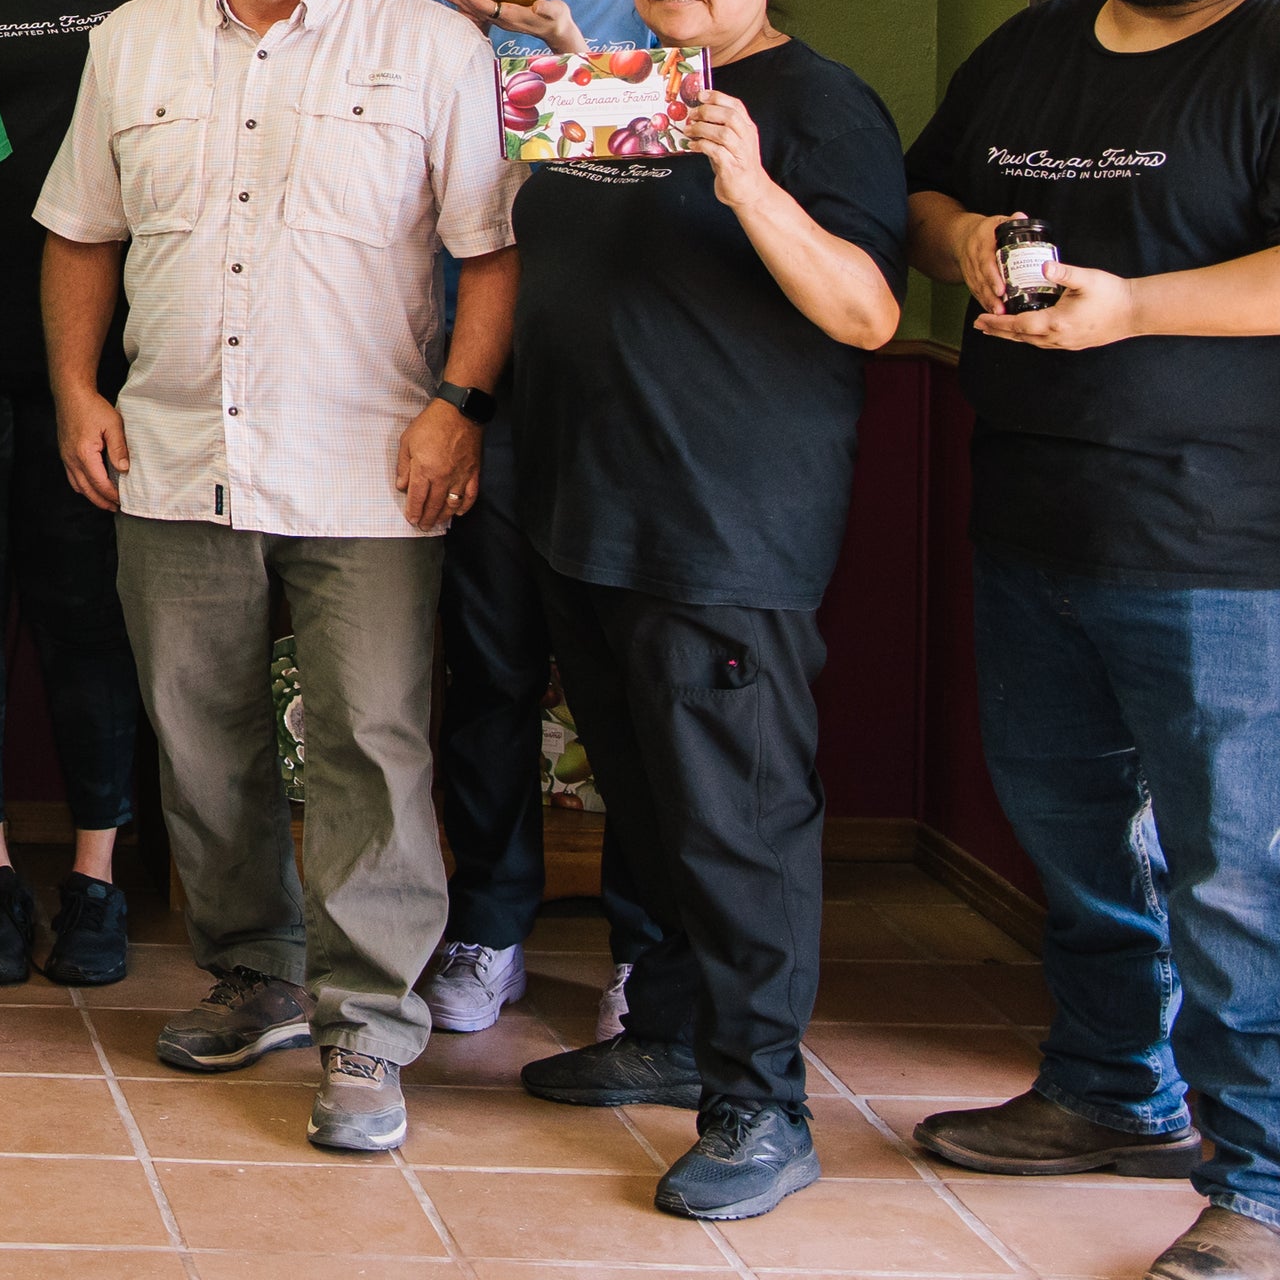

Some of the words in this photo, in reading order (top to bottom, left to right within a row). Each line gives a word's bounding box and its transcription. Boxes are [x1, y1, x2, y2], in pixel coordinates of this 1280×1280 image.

[59, 11, 113, 27] Farm
[61, 25, 94, 34] UTOPI
[548, 95, 574, 107] New
[577, 94, 620, 106] Canaan
[623, 91, 661, 103] Farms
[987, 146, 1026, 166] New
[1097, 148, 1167, 167] Farms
[622, 164, 673, 179] Farms
[1079, 170, 1090, 179] IN
[1093, 169, 1132, 179] UTOPIA
